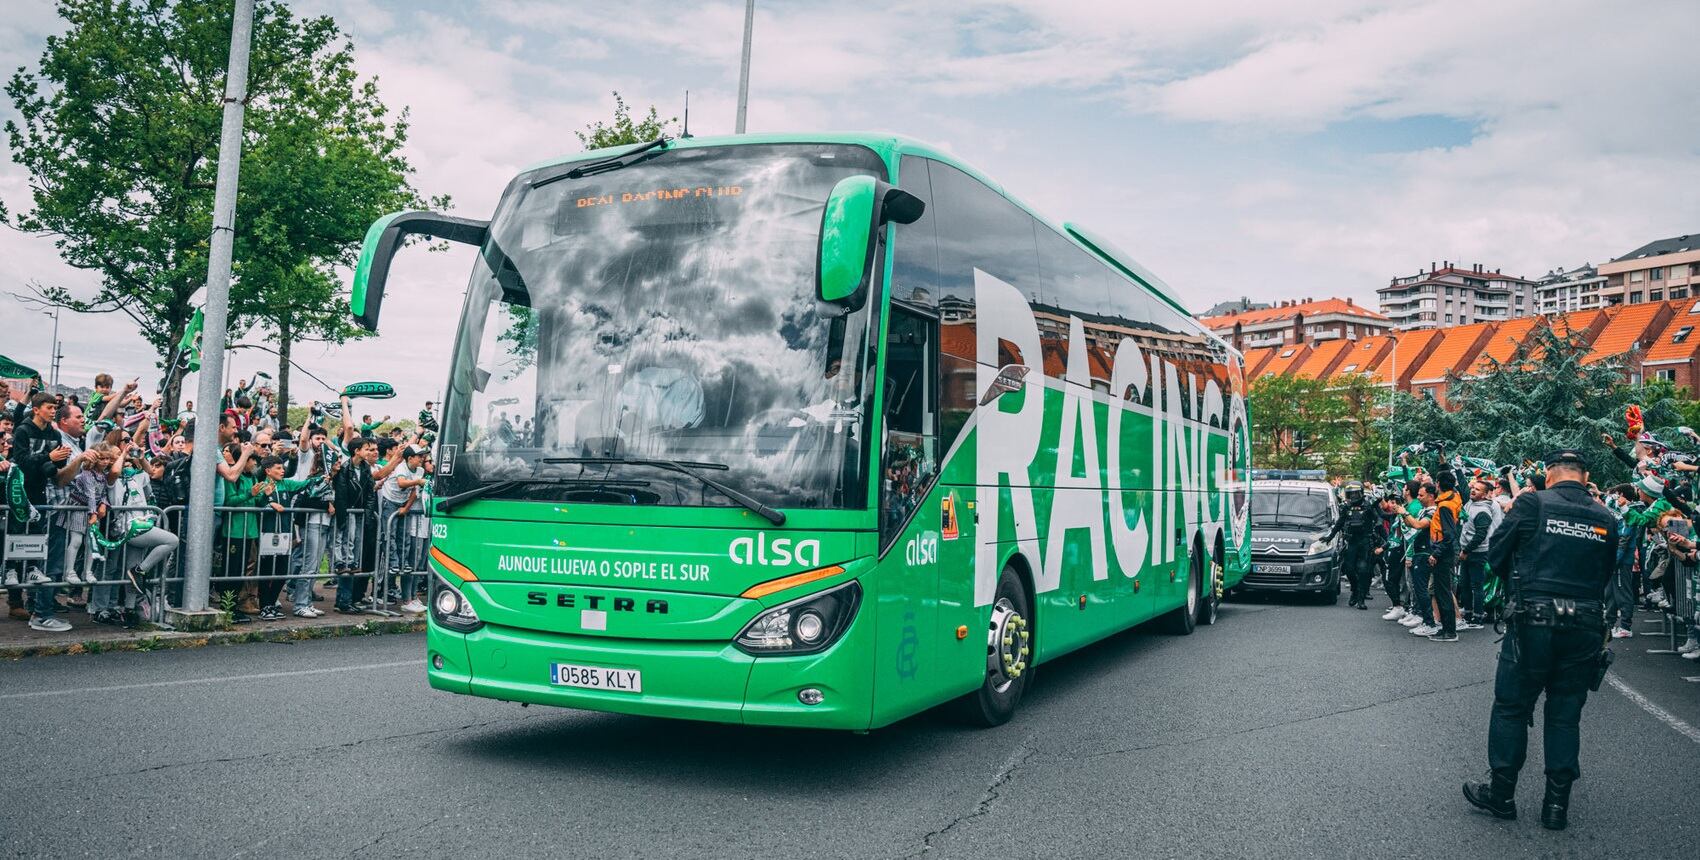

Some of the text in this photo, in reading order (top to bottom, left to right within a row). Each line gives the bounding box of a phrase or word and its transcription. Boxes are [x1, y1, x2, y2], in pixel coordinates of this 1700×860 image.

[973, 267, 1227, 608] RACING
[1546, 526, 1606, 543] NACIONAL
[1547, 519, 1596, 533] POLICIA
[729, 531, 820, 567] alsa
[906, 533, 938, 566] alsa
[498, 555, 710, 582] AUNQUE LLUEVA O SOPLE EL SUR
[527, 591, 668, 614] SETRA
[561, 666, 636, 689] 0585 KLY
